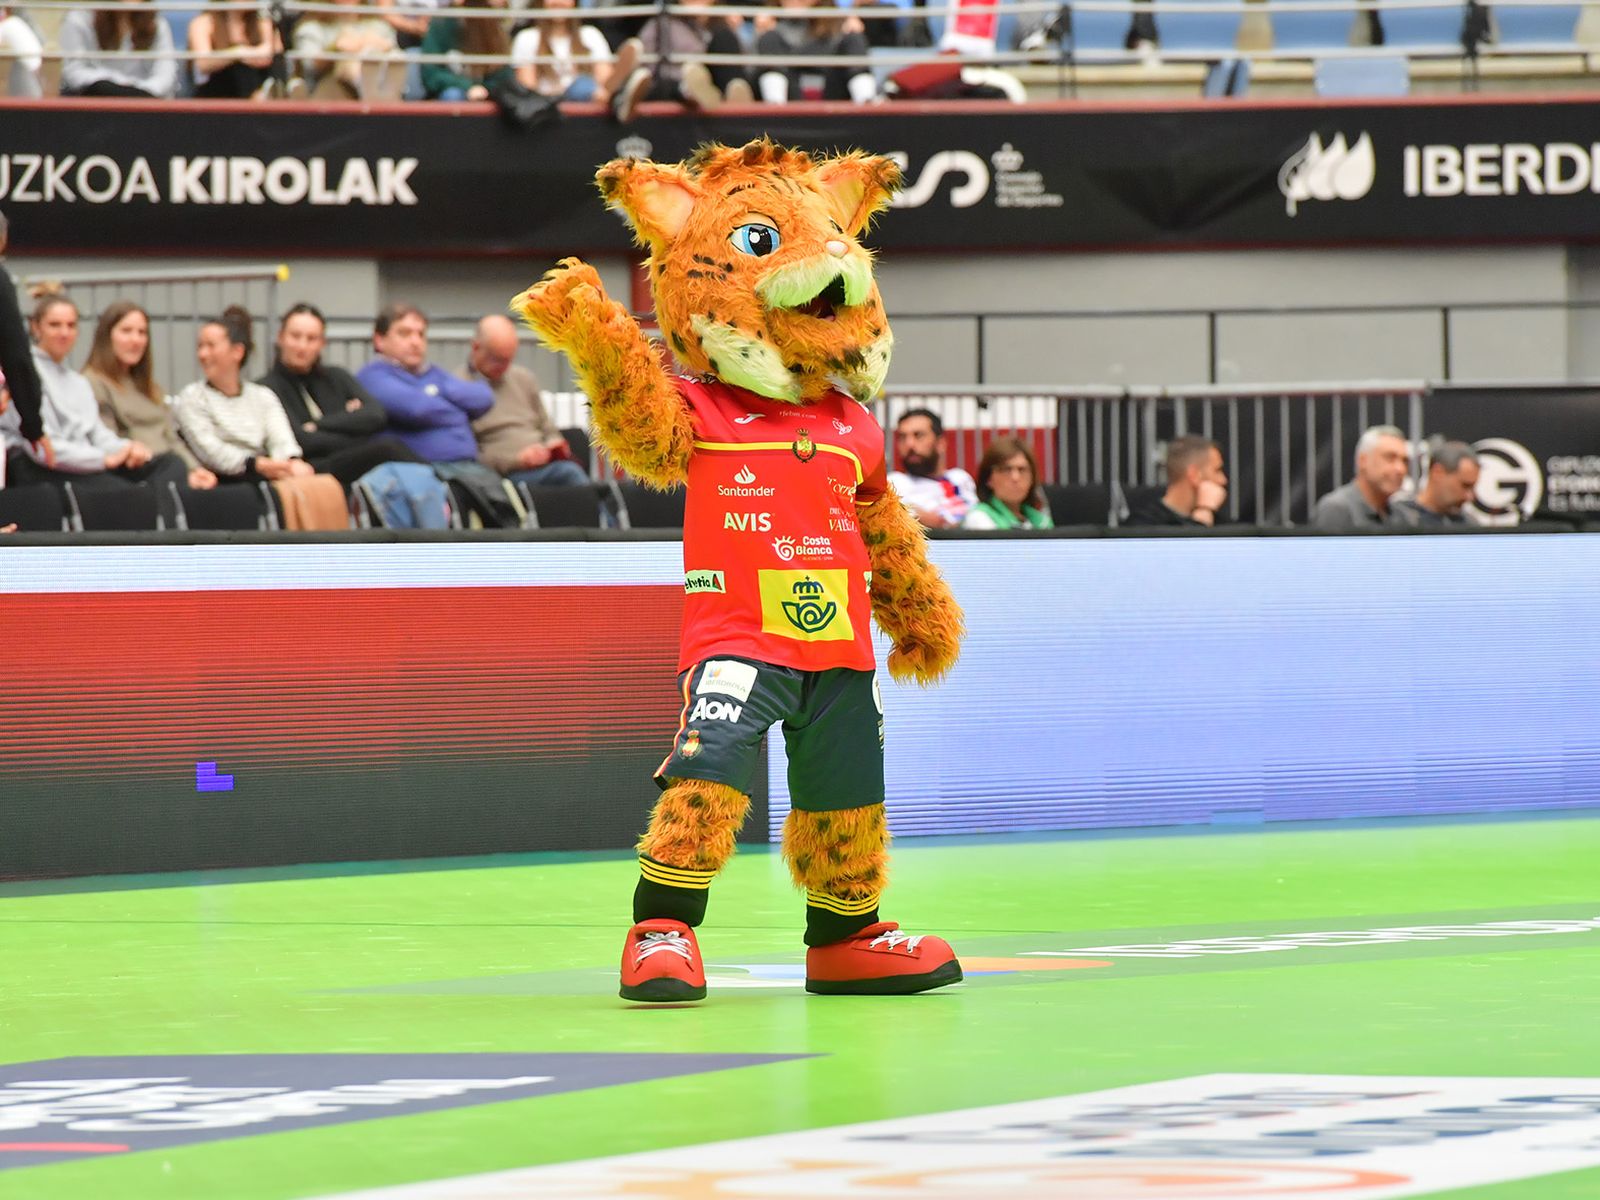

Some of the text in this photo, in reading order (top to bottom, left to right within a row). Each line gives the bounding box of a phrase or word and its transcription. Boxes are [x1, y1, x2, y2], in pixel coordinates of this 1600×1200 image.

[168, 156, 419, 204] KIROLAK
[1403, 142, 1600, 197] IBERD
[717, 484, 776, 497] Santander
[723, 511, 773, 532] AVIS
[795, 545, 833, 555] Blanca
[802, 535, 831, 546] Costa
[689, 697, 743, 723] AON
